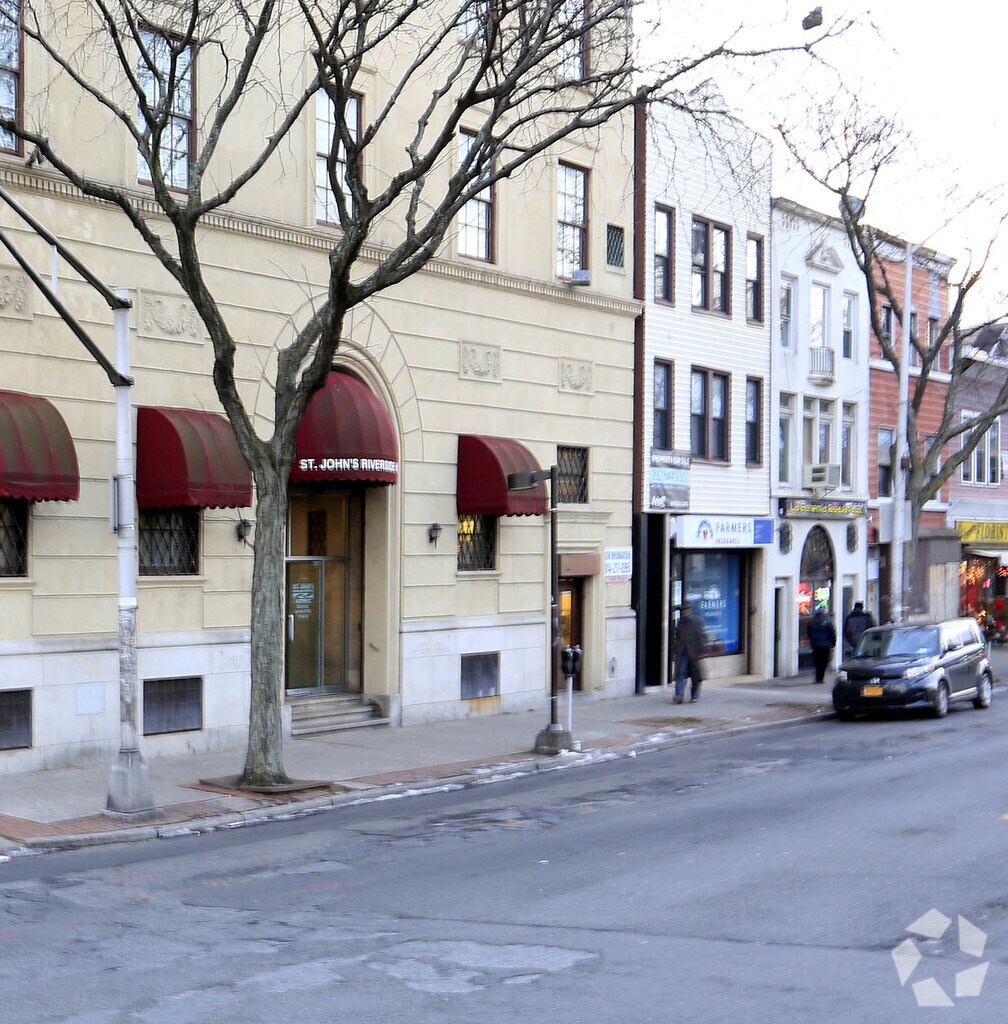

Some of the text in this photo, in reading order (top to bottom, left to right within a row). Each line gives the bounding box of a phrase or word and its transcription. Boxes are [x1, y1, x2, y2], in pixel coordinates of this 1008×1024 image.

[299, 458, 318, 471] ST.
[320, 458, 359, 471] JOHN'S
[360, 458, 396, 472] RIVERSIDE
[715, 521, 752, 534] FARMERS
